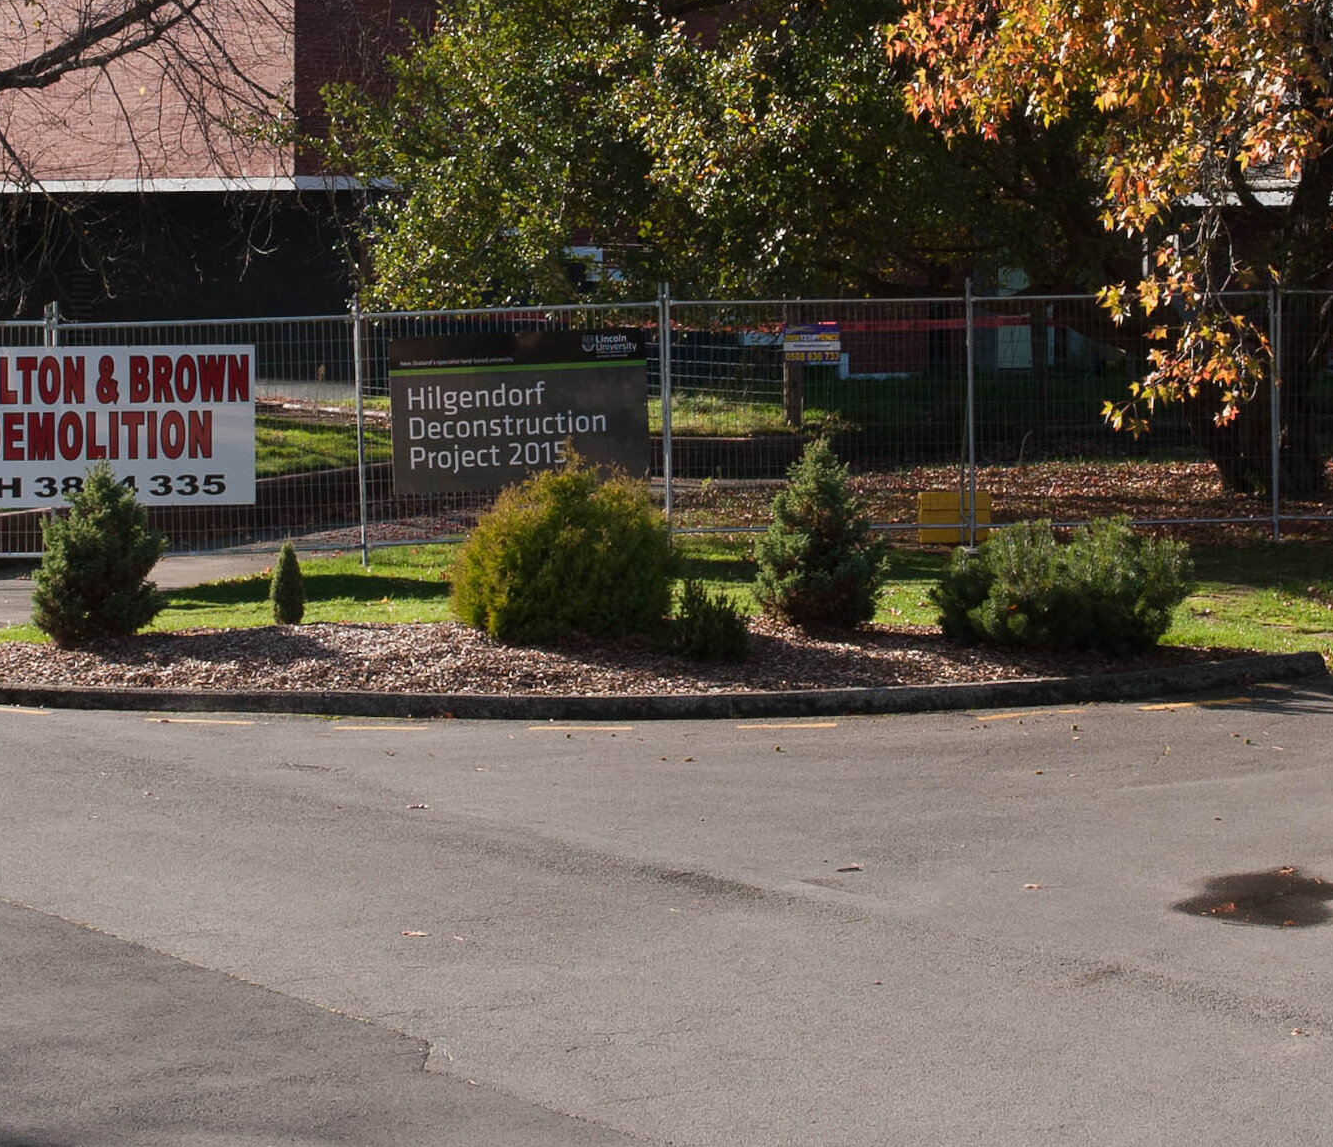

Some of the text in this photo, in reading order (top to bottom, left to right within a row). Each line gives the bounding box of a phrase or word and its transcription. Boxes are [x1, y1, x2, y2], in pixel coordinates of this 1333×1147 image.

[595, 334, 628, 343] Lincoln
[595, 341, 638, 353] University
[96, 355, 120, 404] &
[129, 354, 250, 403] BROWN
[408, 380, 546, 415] Hilgendorf
[409, 410, 607, 440] Deconstruction
[410, 441, 567, 473] Project 2015
[34, 475, 140, 498] 384
[148, 474, 226, 497] 335
